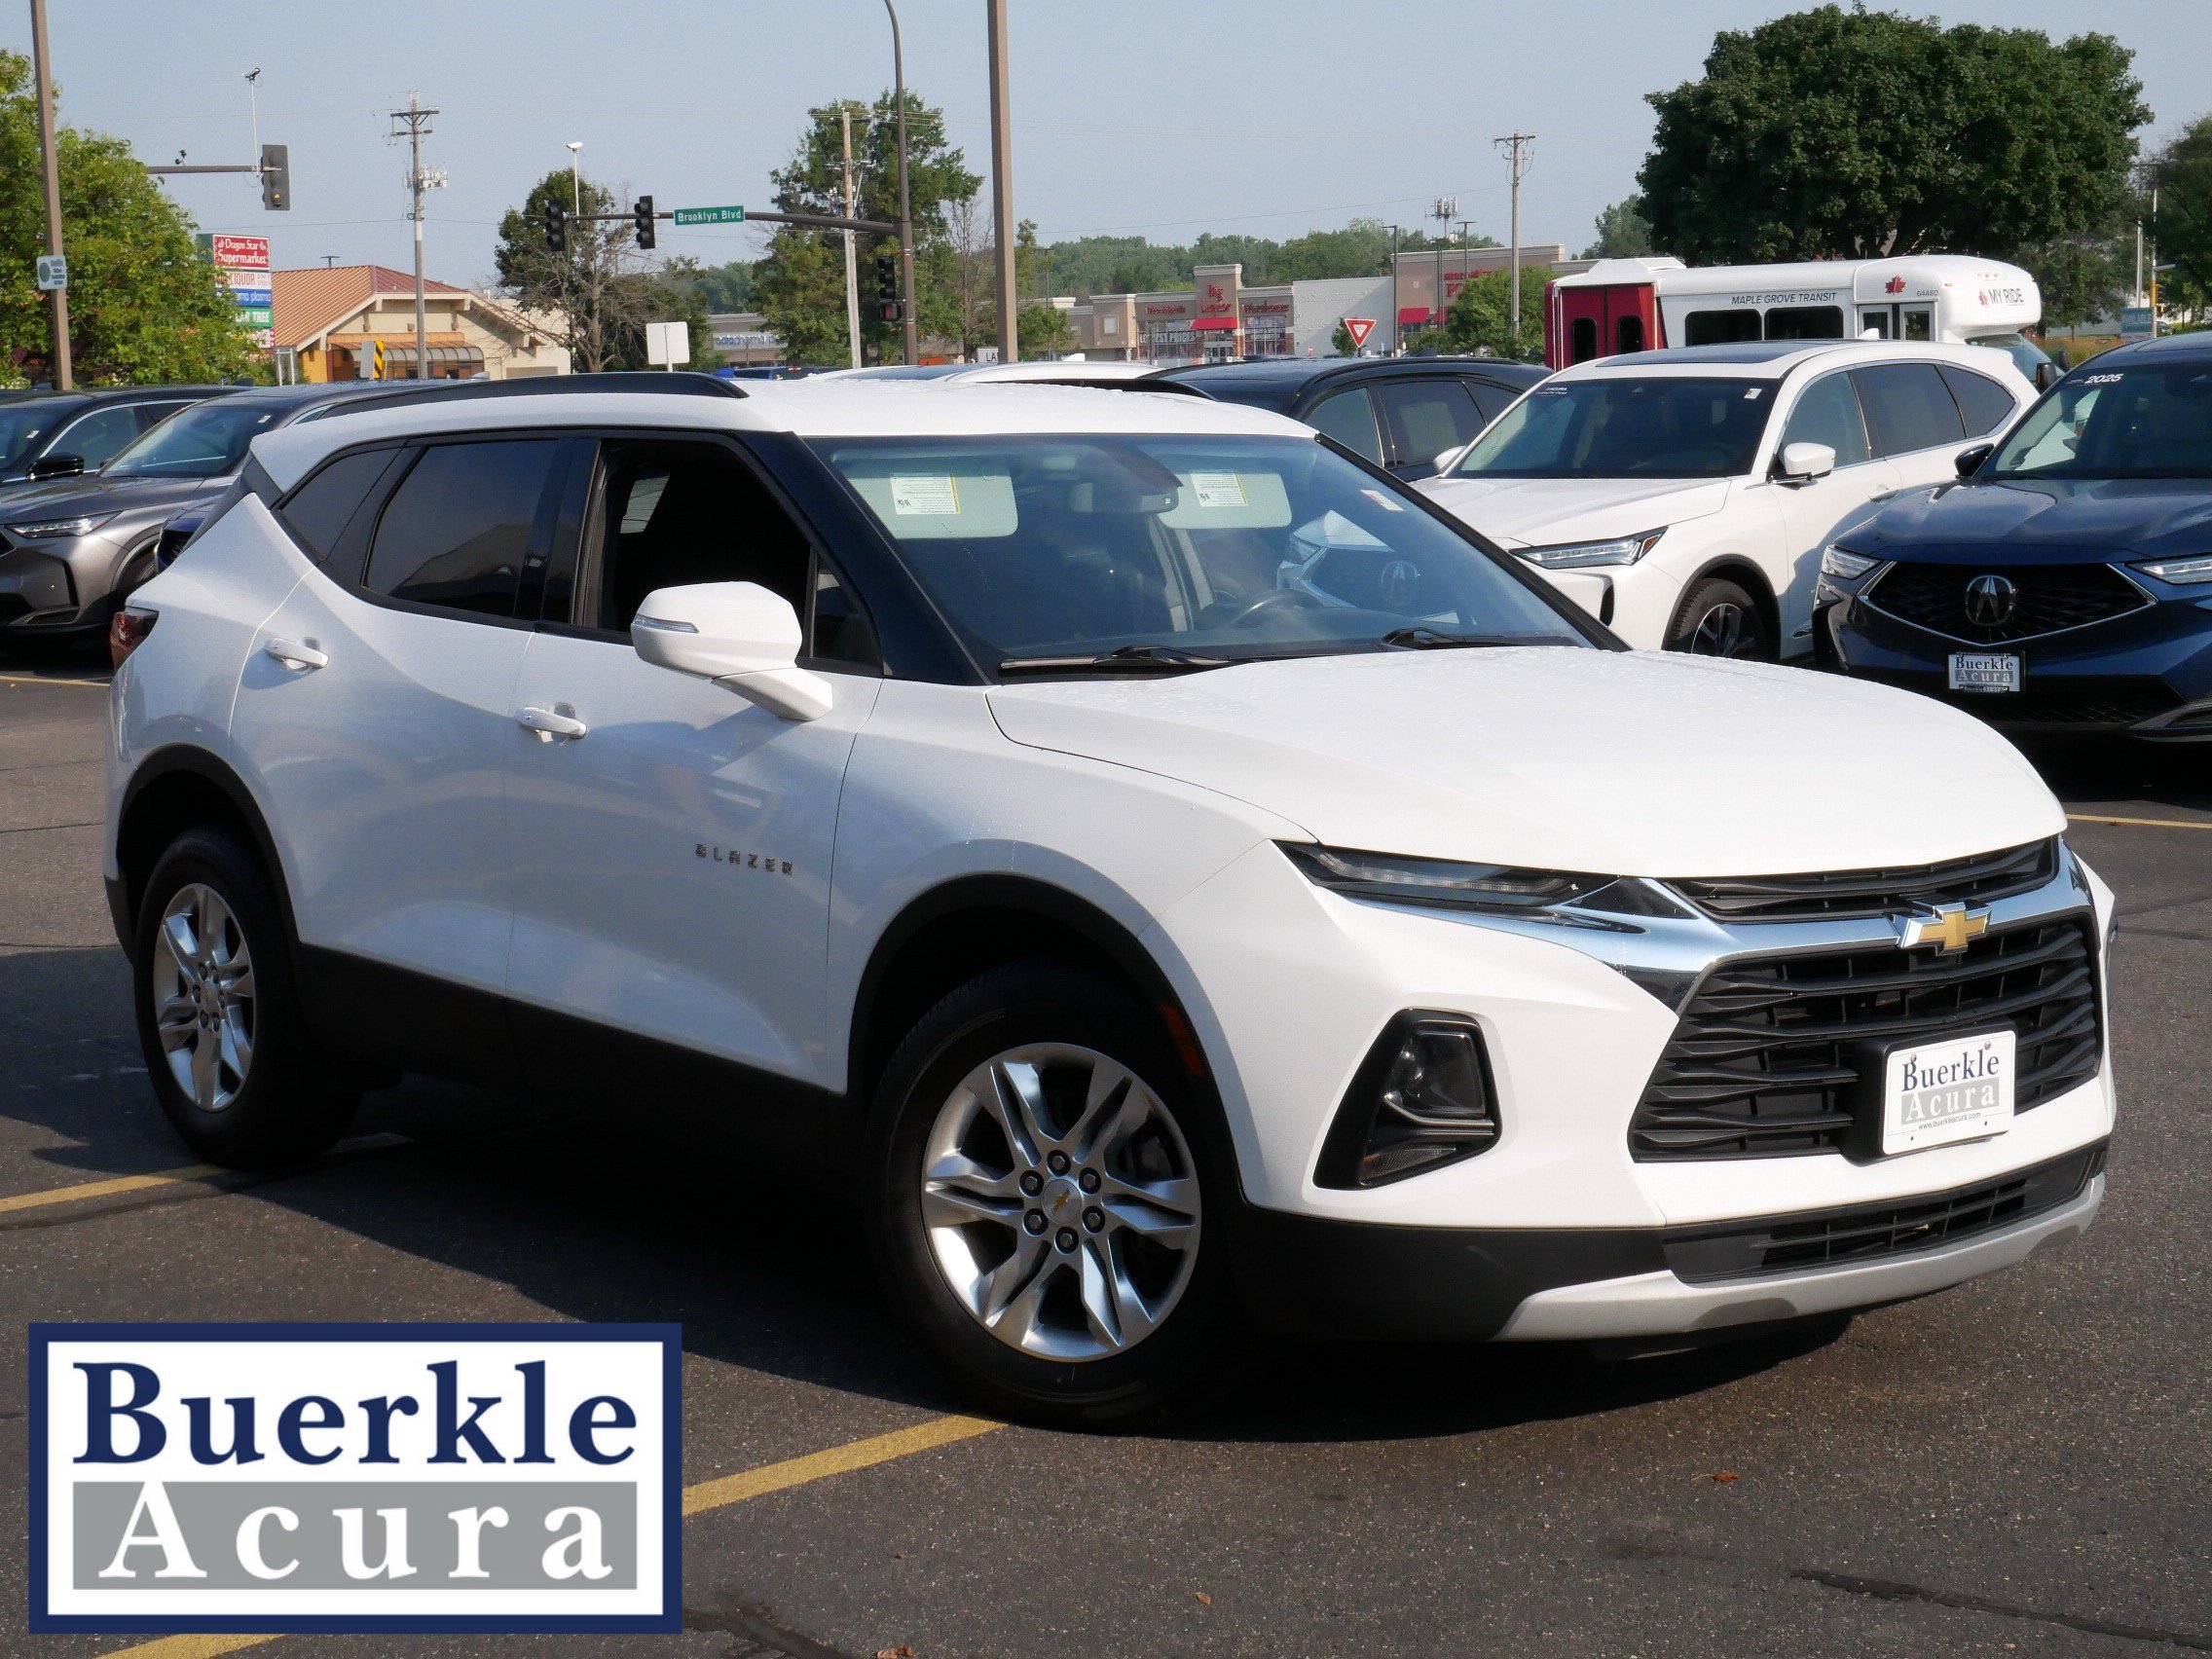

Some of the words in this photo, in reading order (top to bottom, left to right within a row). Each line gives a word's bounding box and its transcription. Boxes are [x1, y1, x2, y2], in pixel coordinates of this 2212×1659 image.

[678, 211, 718, 222] Brooklyn
[720, 209, 741, 219] Blvd
[225, 239, 245, 251] Dragon
[246, 240, 258, 250] Star
[218, 249, 268, 265] Supermarket
[230, 274, 255, 285] LIQUOR
[1731, 295, 1762, 305] MAPLE
[1764, 293, 1795, 304] GROVE
[1798, 292, 1836, 303] TRANSIT
[1988, 288, 2003, 304] MY
[2003, 288, 2024, 303] RIDE
[252, 312, 270, 322] TREE
[2084, 374, 2123, 385] 2025
[1955, 656, 2013, 671] Buerkle
[1958, 670, 2011, 682] Acura
[695, 843, 793, 876] BLAZER
[1901, 1049, 2000, 1092] Buerkle
[1905, 1083, 1996, 1122] Acura
[1918, 1111, 1981, 1130] www.buerkleacura.com
